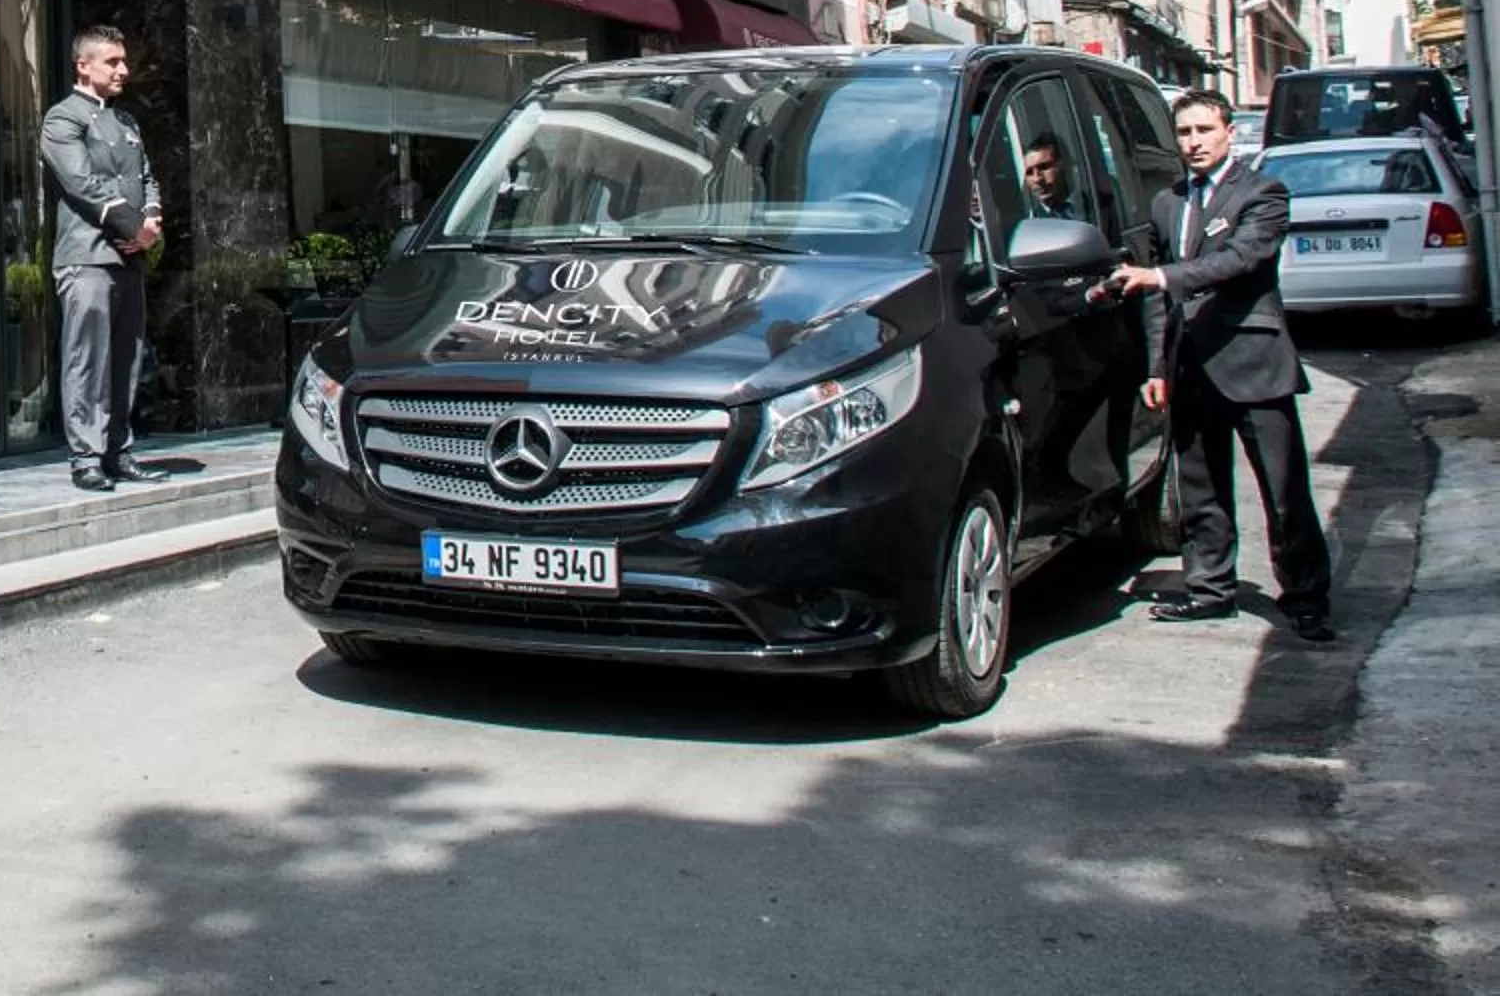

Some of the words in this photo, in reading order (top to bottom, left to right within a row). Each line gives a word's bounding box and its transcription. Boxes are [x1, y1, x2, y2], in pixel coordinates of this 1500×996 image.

[455, 301, 667, 326] DENCITY
[493, 329, 600, 346] HOTEL
[443, 541, 475, 575] 34
[487, 544, 521, 577] NF
[534, 547, 606, 583] 9340
